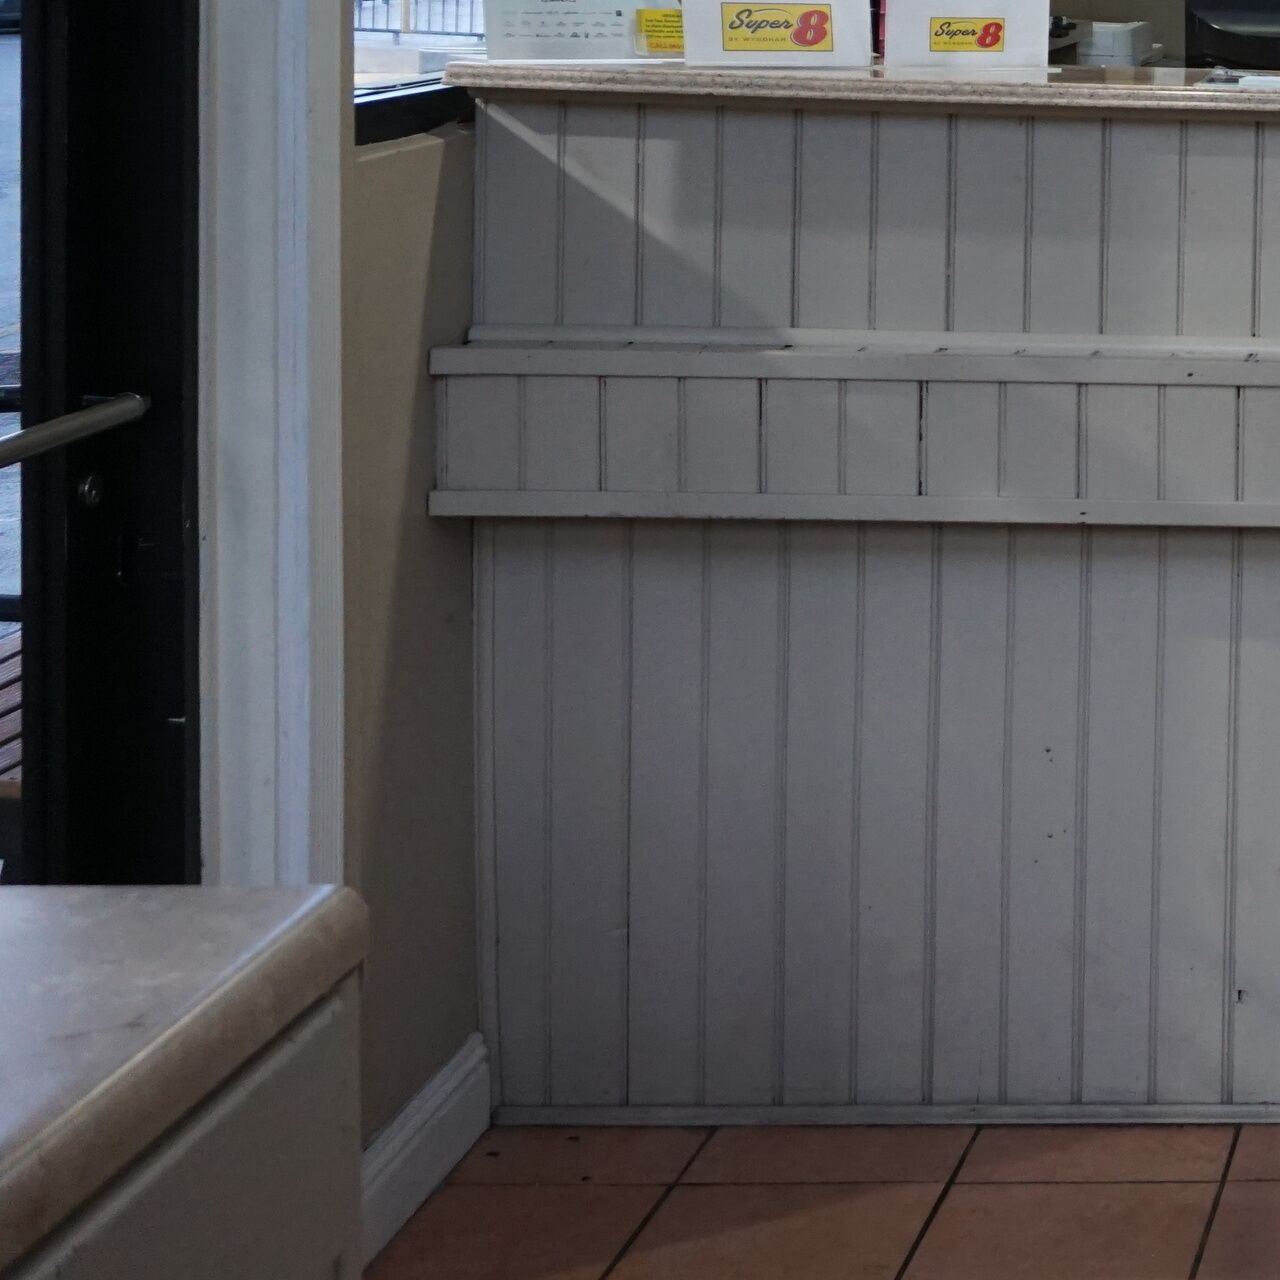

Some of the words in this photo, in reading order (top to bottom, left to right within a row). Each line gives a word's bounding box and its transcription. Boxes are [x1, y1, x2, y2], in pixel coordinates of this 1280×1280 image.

[729, 8, 793, 34] Super
[790, 10, 829, 47] 8
[935, 22, 977, 39] Super
[976, 22, 1002, 48] 8
